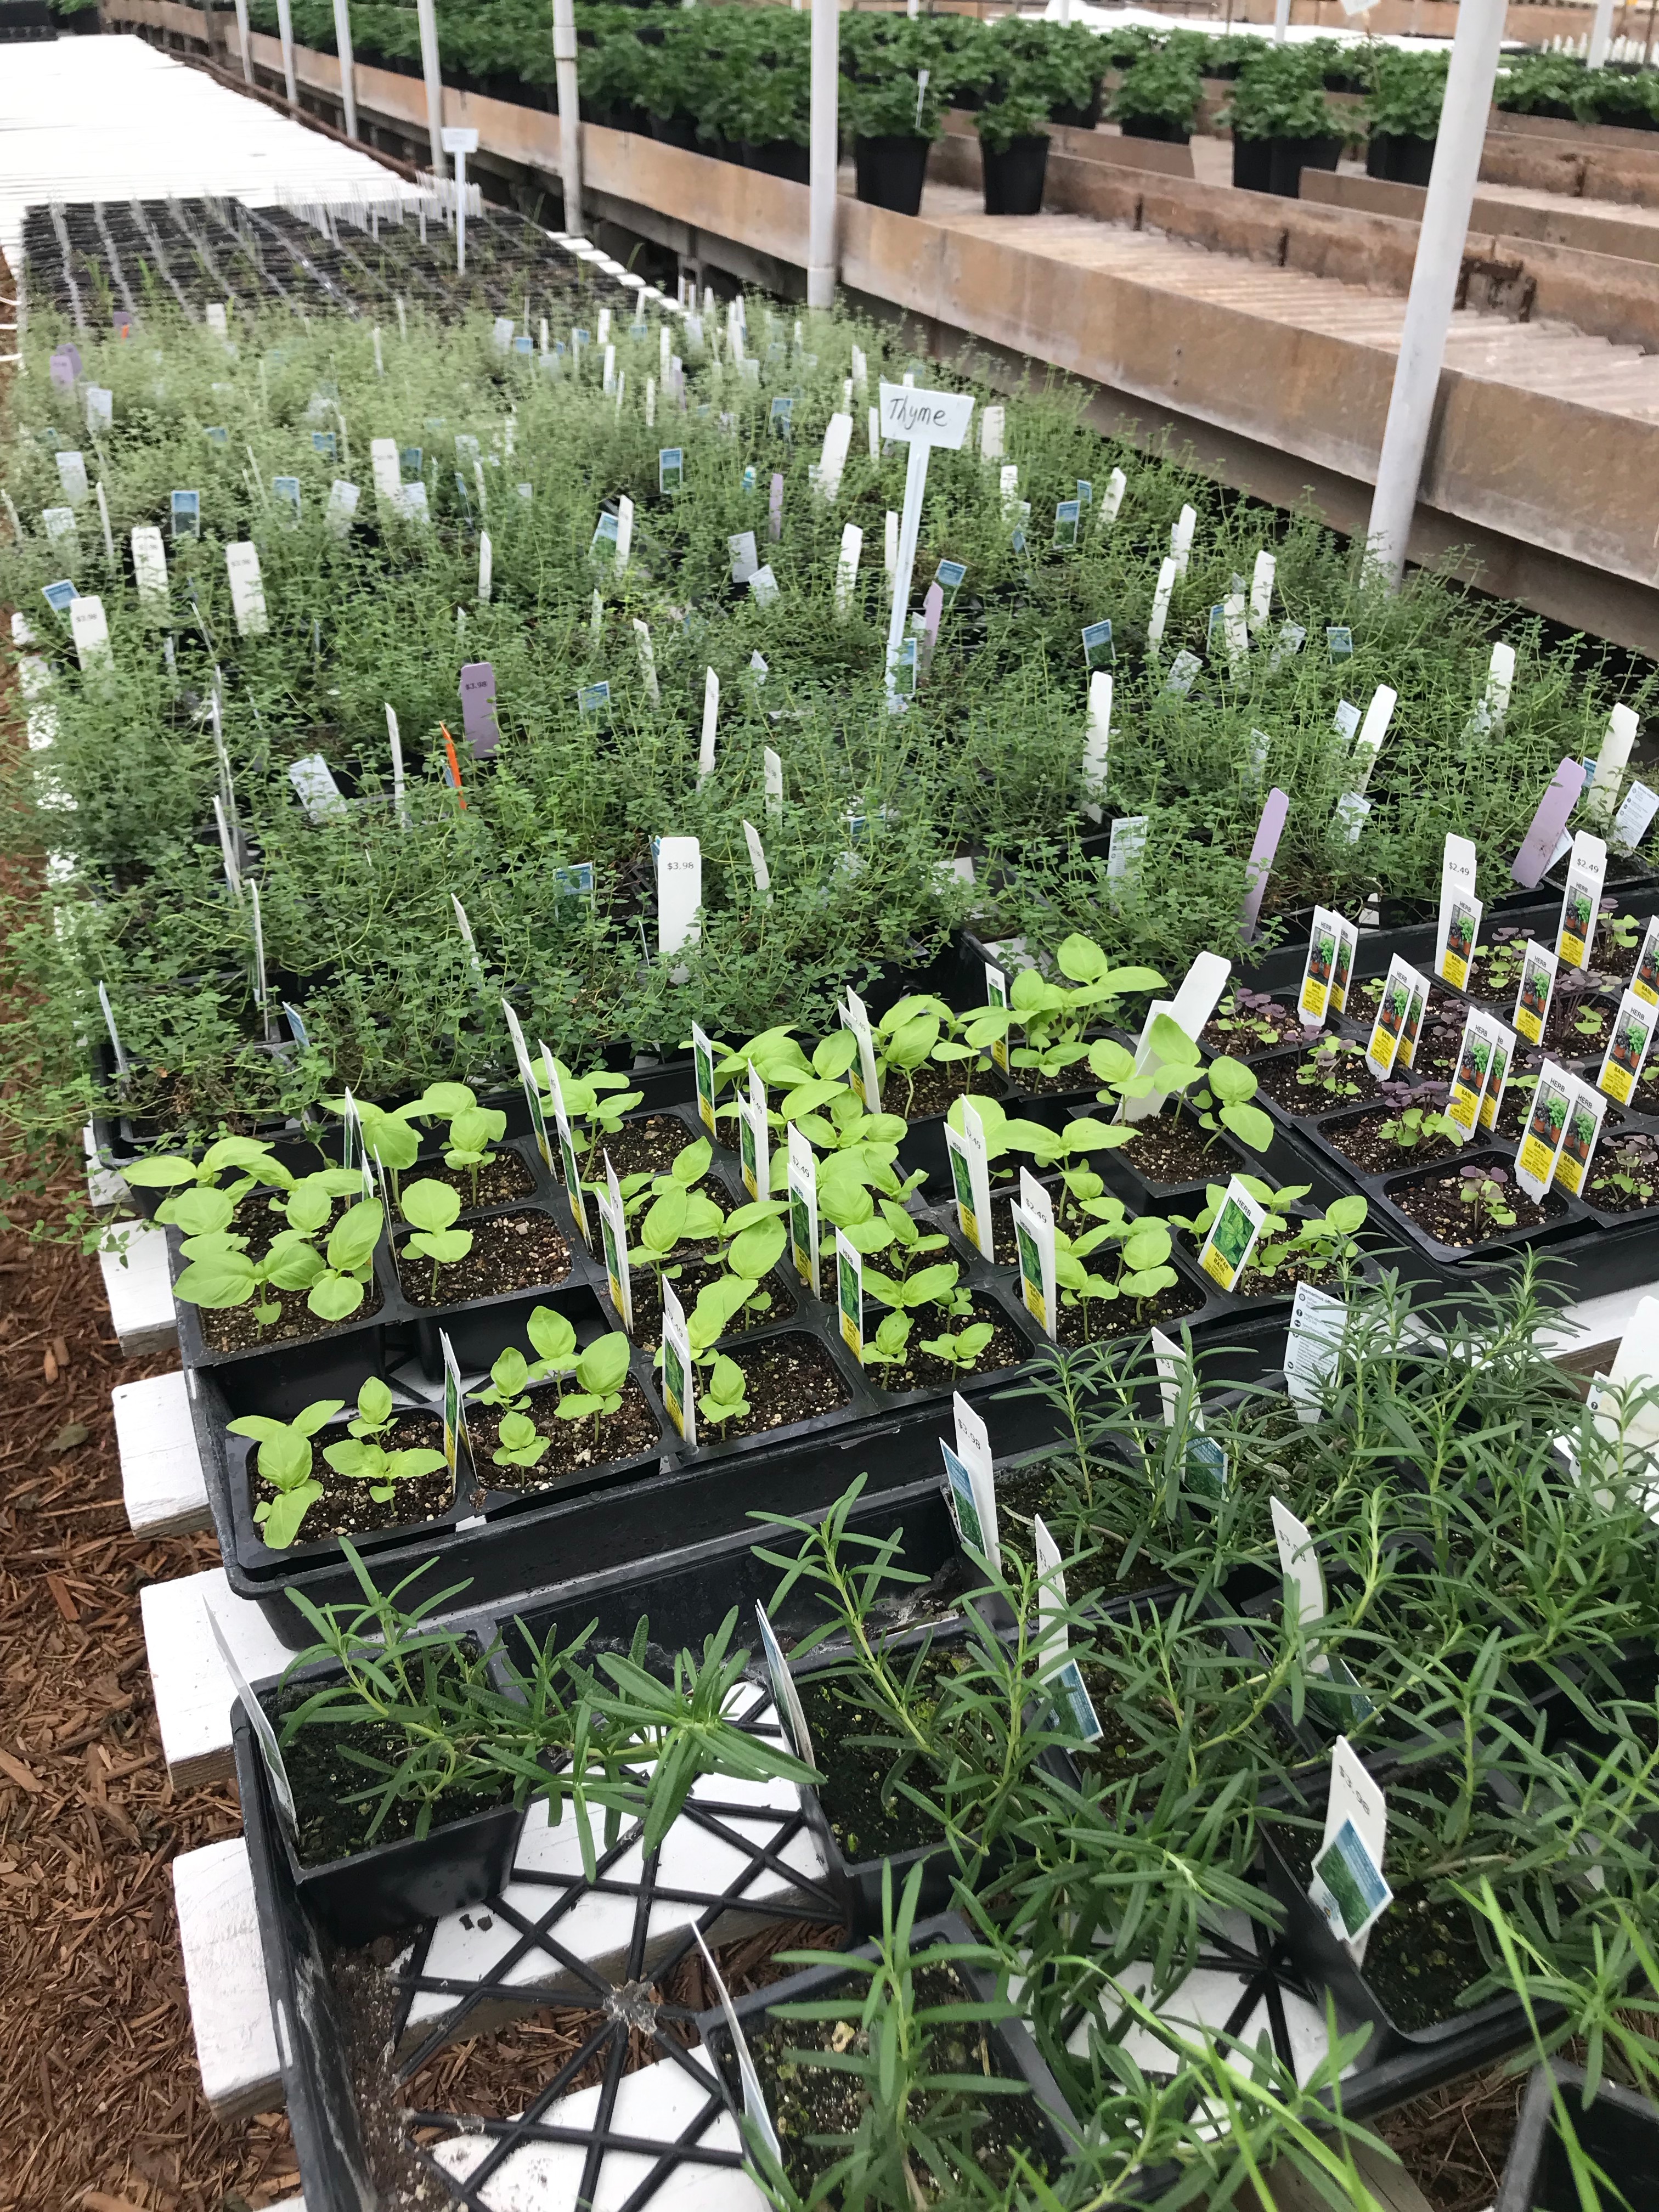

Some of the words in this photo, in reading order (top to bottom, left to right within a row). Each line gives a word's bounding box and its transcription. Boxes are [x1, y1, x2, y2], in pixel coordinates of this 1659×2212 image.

[890, 394, 948, 430] Thyme
[465, 681, 488, 690] $3.98
[667, 861, 695, 871] $3.98
[1448, 860, 1470, 877] $2.49
[1576, 857, 1599, 874] $2.49
[1576, 881, 1588, 893] HERB
[1459, 901, 1472, 913] HERB
[1320, 921, 1332, 932] HERB
[1340, 929, 1349, 939] ERB
[1534, 955, 1547, 968] HERB
[1396, 970, 1408, 984] HERB
[1630, 1007, 1645, 1021] HERB
[1475, 1024, 1488, 1038] HERB
[1550, 1077, 1565, 1093] HERB
[1578, 1093, 1593, 1109] HERB
[1533, 1140, 1547, 1154] BASIL
[792, 1155, 810, 1178] $2.49
[794, 1183, 804, 1199] HERB
[1025, 1198, 1047, 1224] $2.49
[1237, 1197, 1252, 1217] HERB
[1214, 1251, 1229, 1271] NUFAR
[1214, 1258, 1226, 1275] BASIL
[957, 1418, 981, 1450] $3.98
[1338, 1764, 1371, 1816] $3.98
